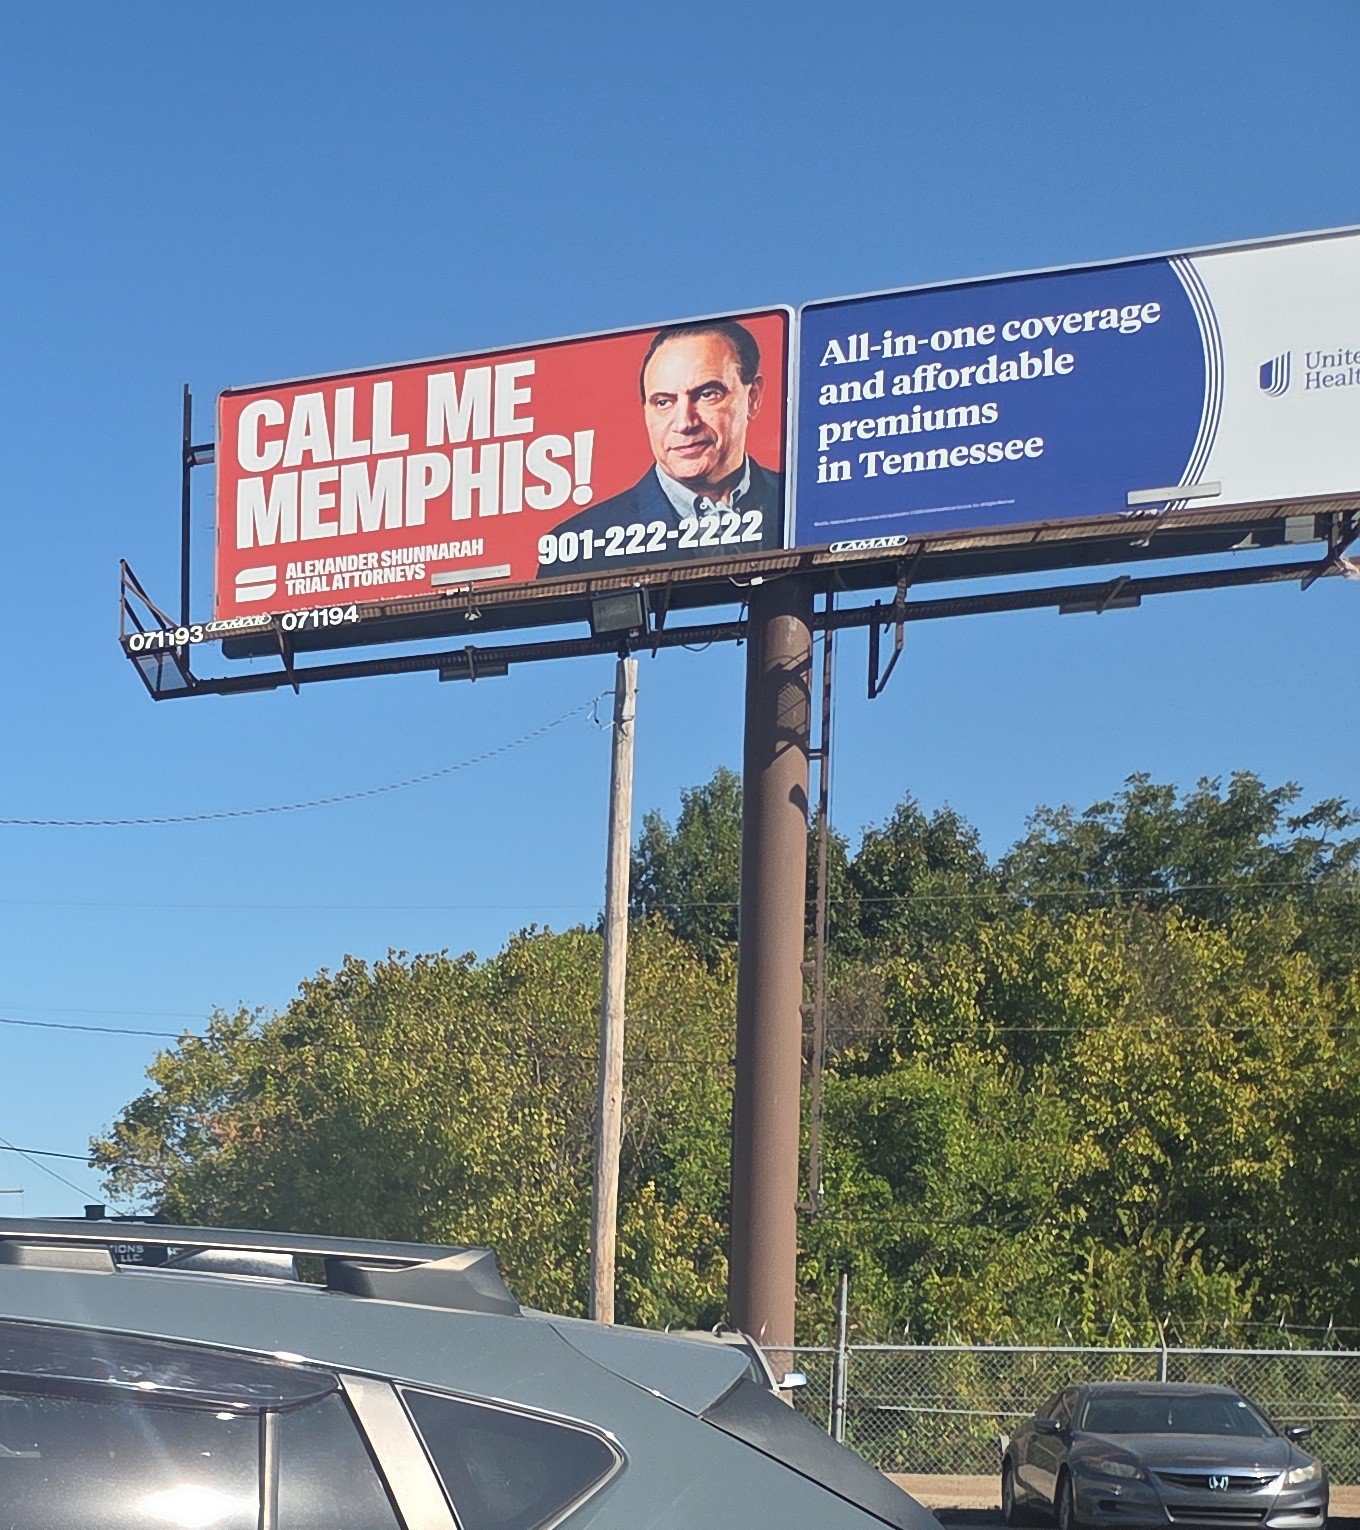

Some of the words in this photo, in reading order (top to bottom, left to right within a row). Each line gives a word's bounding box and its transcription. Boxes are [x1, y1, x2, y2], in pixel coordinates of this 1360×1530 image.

[819, 324, 995, 367] All-in-one
[1002, 302, 1161, 337] coverage
[818, 371, 885, 405] and
[891, 348, 1074, 395] affordable
[237, 380, 410, 473] CALL
[426, 359, 535, 447] ME
[818, 402, 998, 451] premiums
[816, 455, 852, 484] in
[858, 436, 1044, 479] Tennessee
[236, 429, 595, 549] MEMPHIS!
[285, 550, 379, 580] ALEXANDER
[380, 538, 484, 567] SHUNNARAH
[537, 510, 763, 565] 901-222-2222
[835, 536, 900, 553] LAMAR
[285, 574, 330, 596] TRIAL
[332, 563, 426, 591] ATTORNEYS
[129, 626, 204, 652] 071193
[208, 614, 268, 632] LAMAR
[281, 605, 359, 632] 071194
